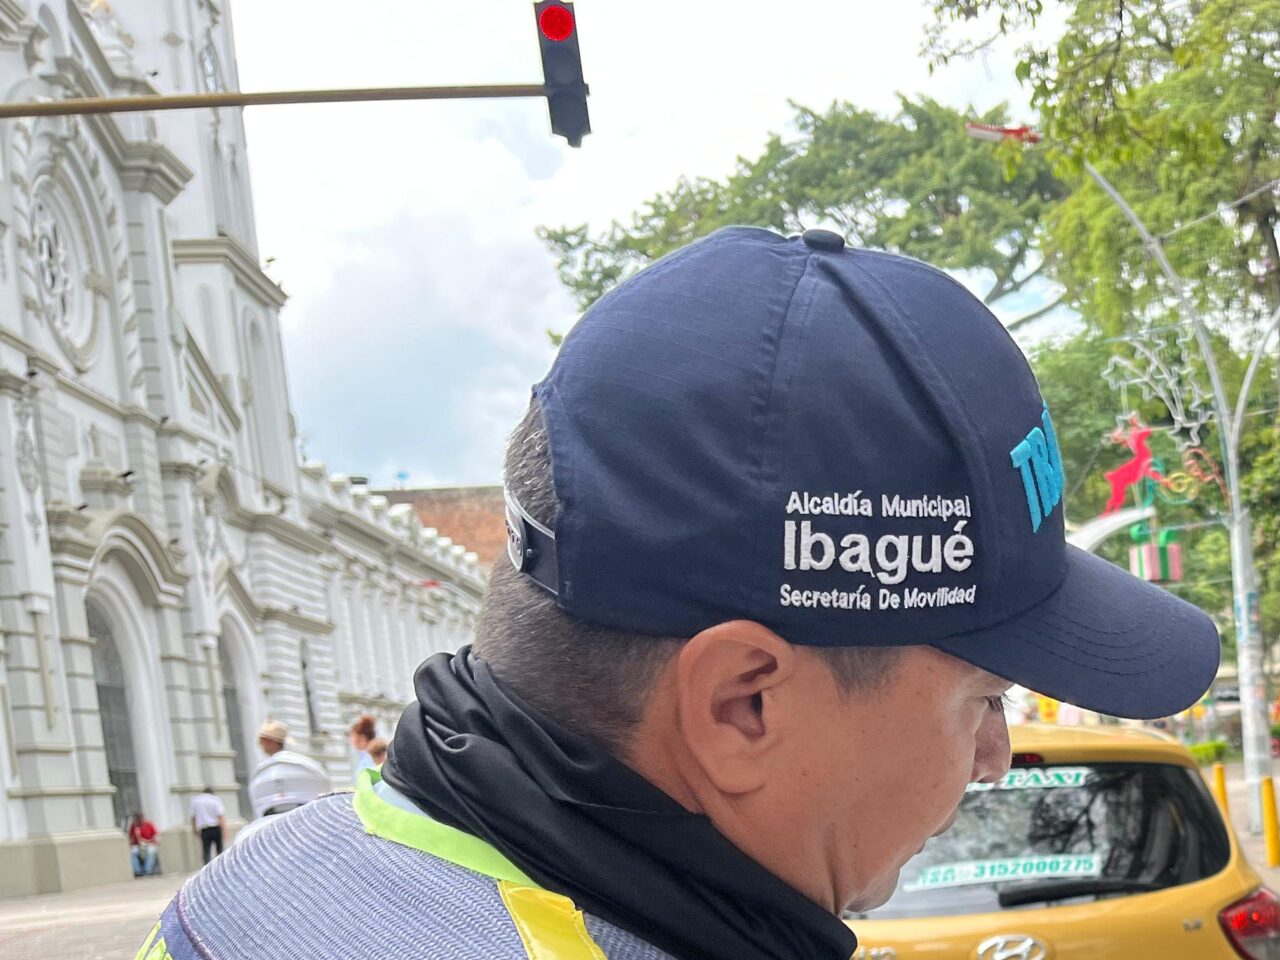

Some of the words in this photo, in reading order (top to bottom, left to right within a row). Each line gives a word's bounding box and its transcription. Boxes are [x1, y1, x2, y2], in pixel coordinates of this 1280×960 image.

[786, 490, 872, 518] Alcaldía
[882, 494, 972, 521] Municipal
[783, 520, 975, 585] Ibagué
[780, 585, 871, 611] Secretaría
[878, 589, 900, 610] De
[903, 585, 976, 610] Movilidad
[1003, 768, 1087, 788] TAXI
[973, 857, 1094, 879] 3152000275
